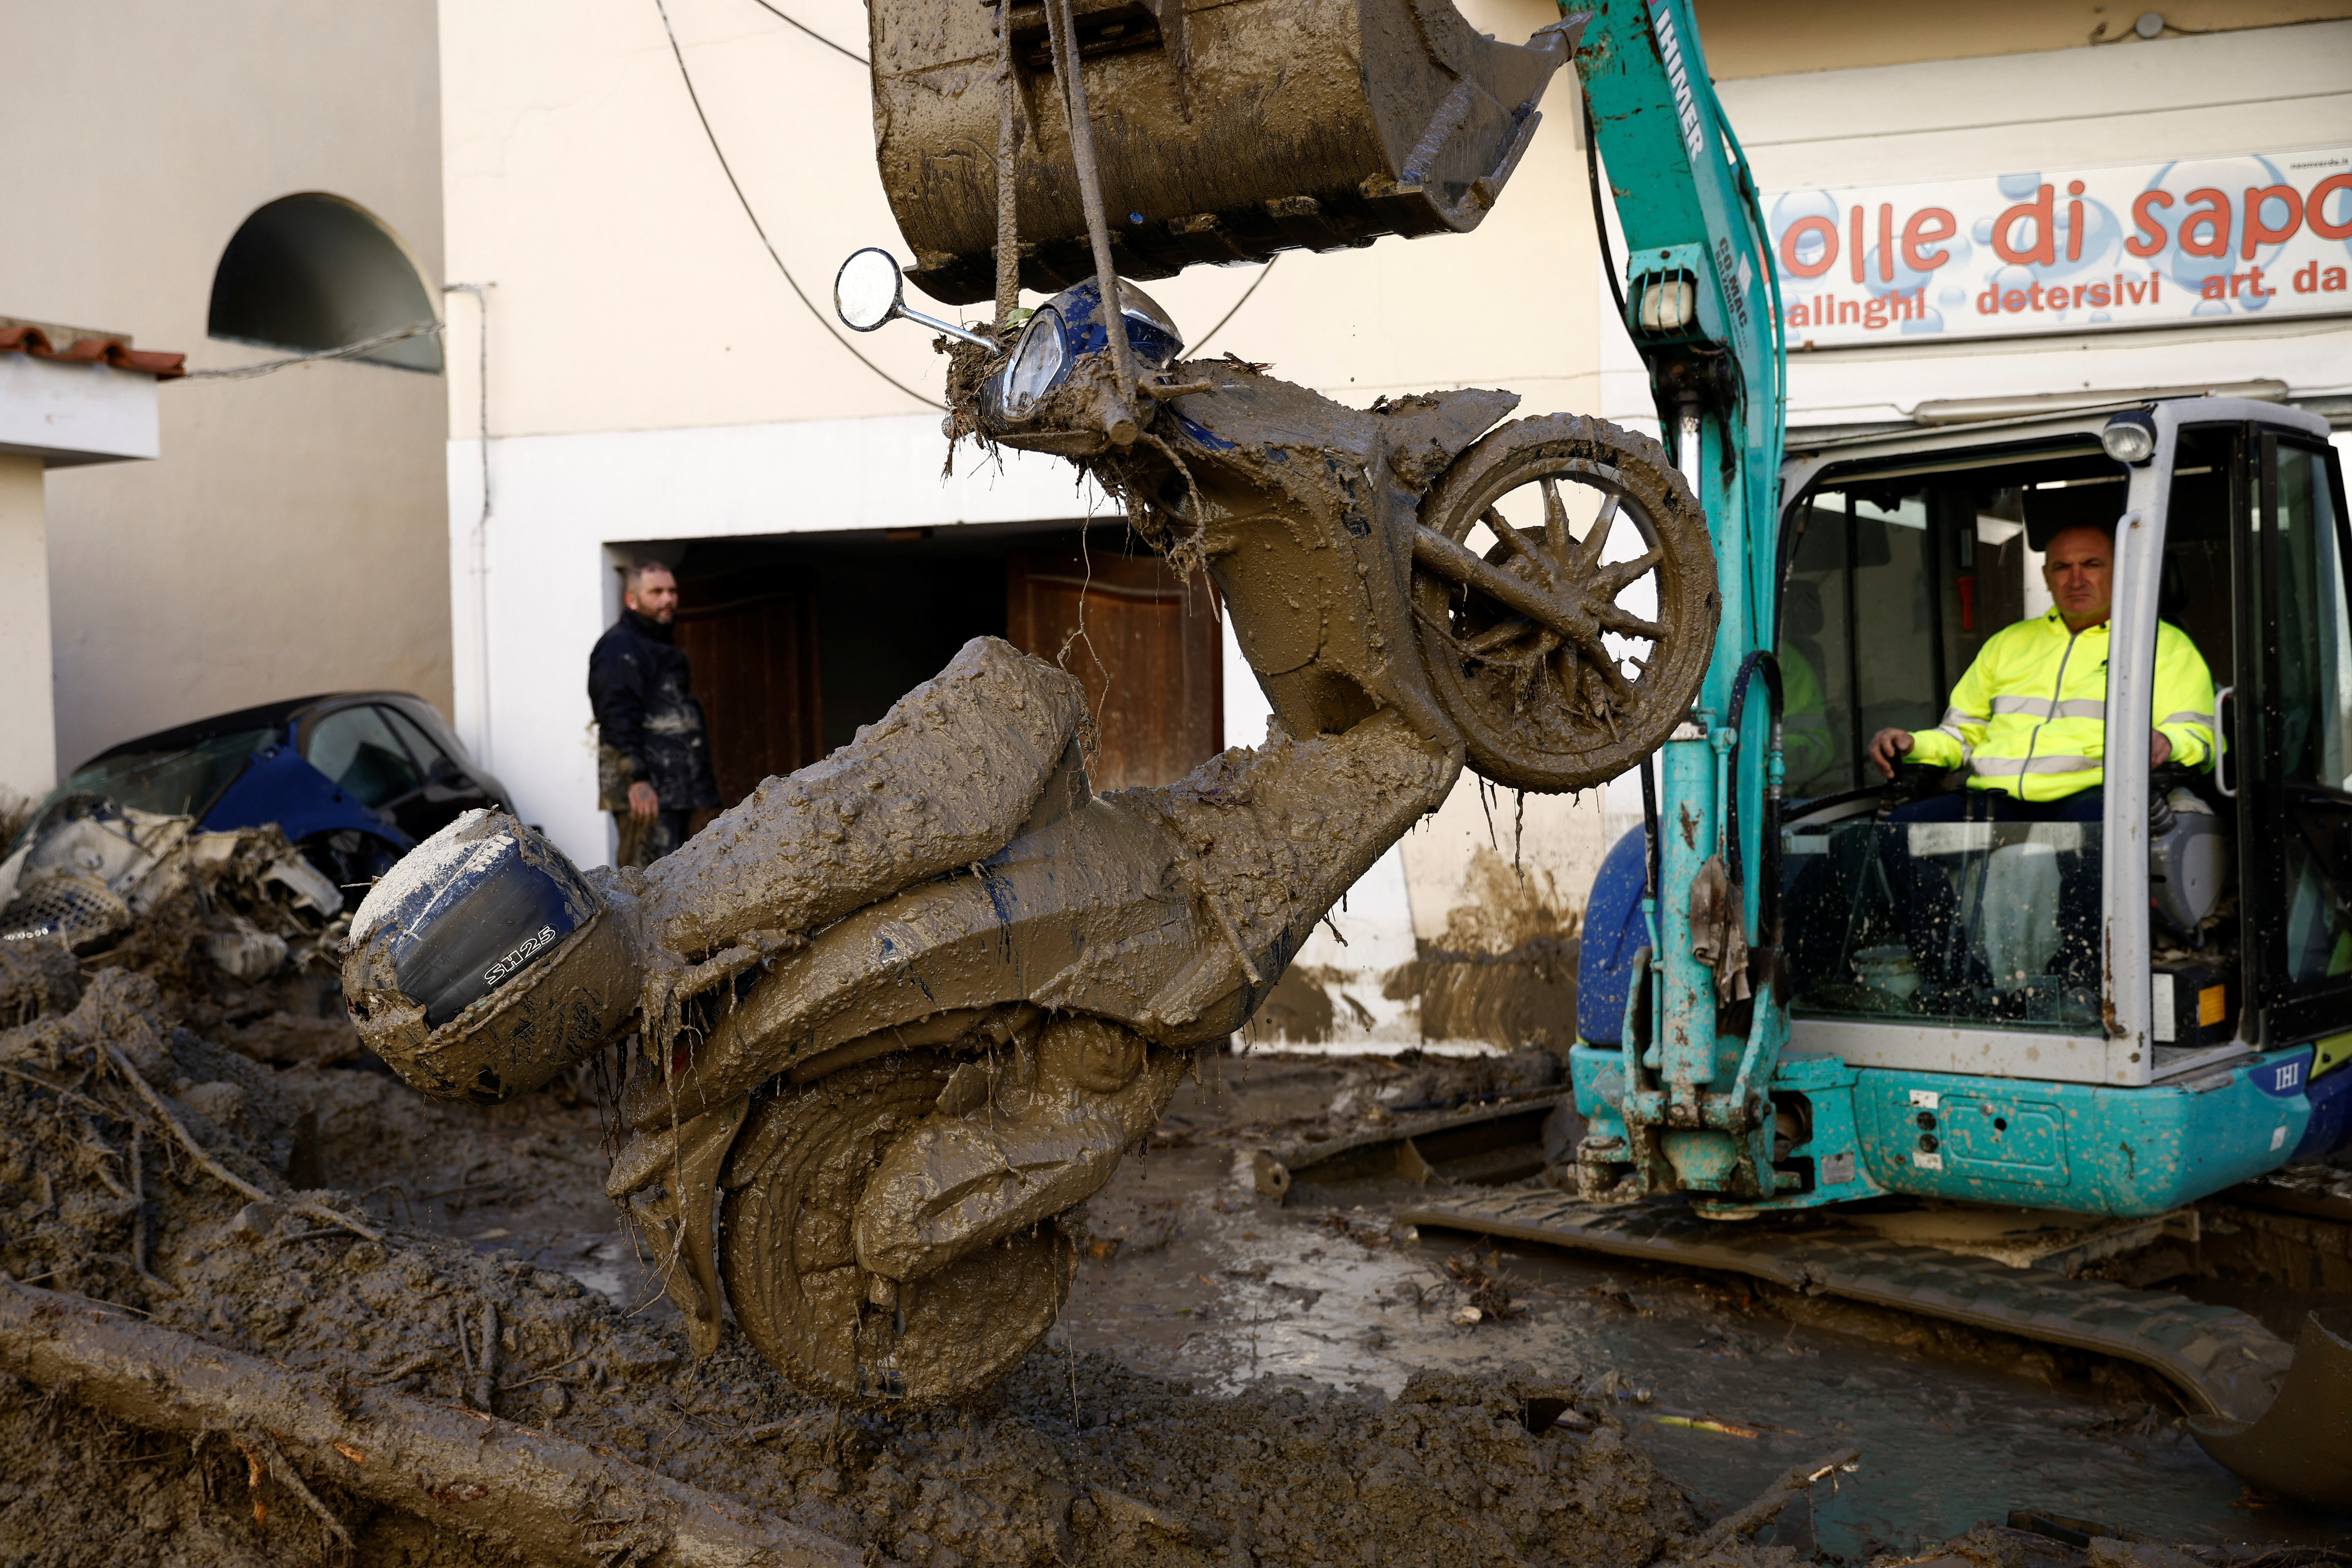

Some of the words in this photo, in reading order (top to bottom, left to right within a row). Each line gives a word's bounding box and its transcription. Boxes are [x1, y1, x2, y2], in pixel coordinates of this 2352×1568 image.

[1655, 7, 1704, 163] IHIMER
[1759, 203, 1957, 284] olle
[1991, 180, 2084, 266] di
[2125, 174, 2352, 261] sapo
[1977, 272, 2159, 315] detersivi
[2201, 265, 2276, 300] art.
[2293, 260, 2347, 294] da
[2275, 1062, 2299, 1090] IHI
